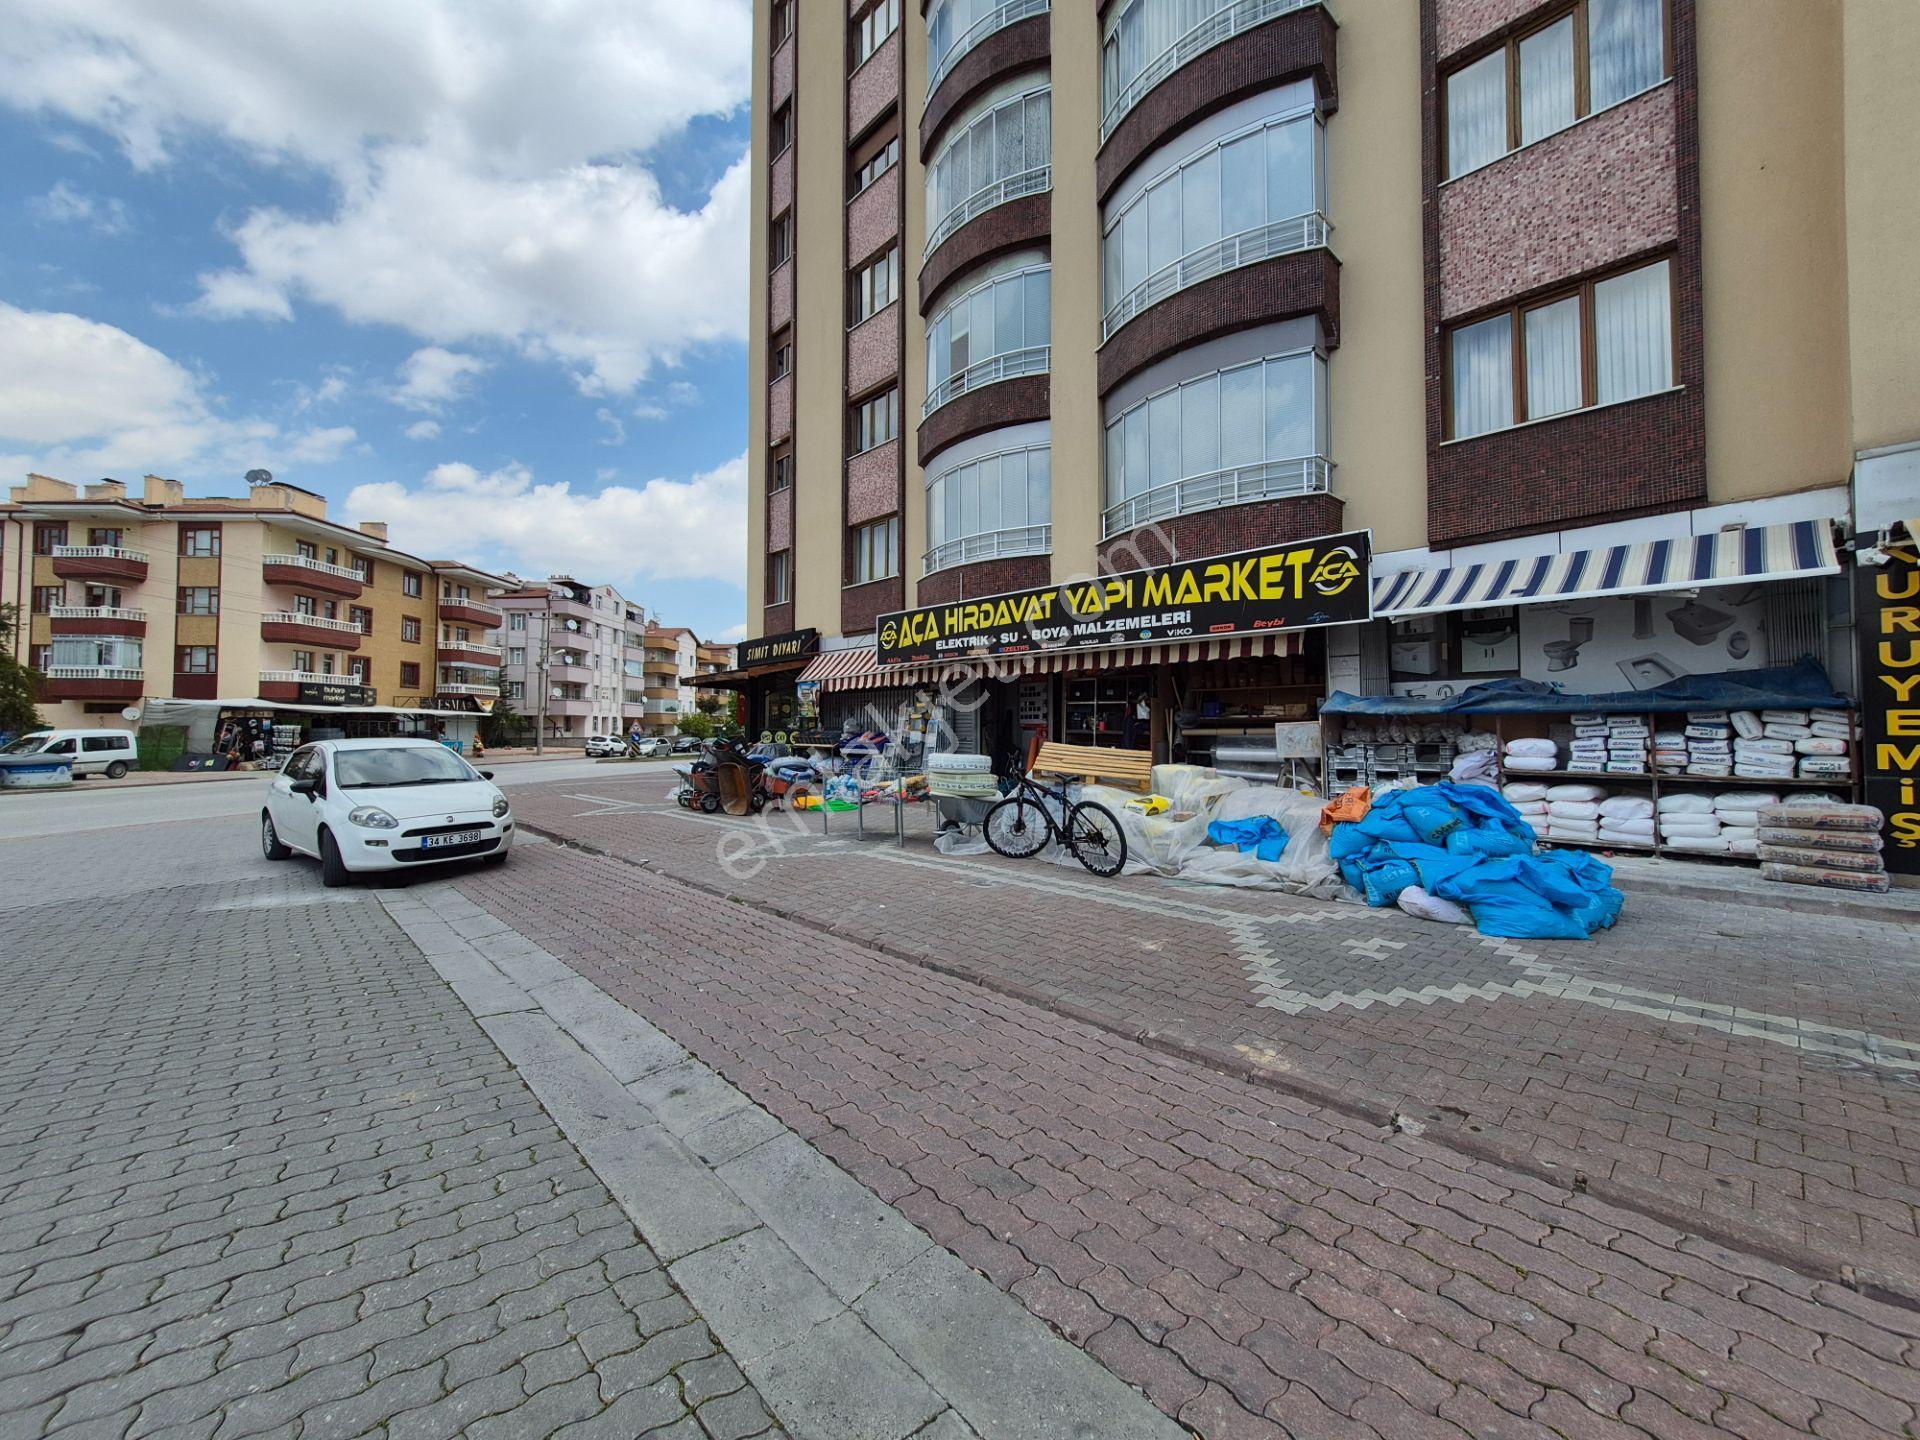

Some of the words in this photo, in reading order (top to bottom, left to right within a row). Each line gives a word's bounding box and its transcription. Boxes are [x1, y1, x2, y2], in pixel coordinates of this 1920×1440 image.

[898, 611, 940, 648] AÇA
[945, 592, 1058, 635] HIRDAVAT
[1065, 579, 1133, 614] YAPI
[1142, 548, 1315, 606] MARKET
[1001, 632, 1019, 644] SU
[1032, 626, 1070, 641] BOYA
[1073, 610, 1191, 635] MALZEMELERİ
[1254, 617, 1286, 629] Beybi
[429, 837, 440, 847] 34
[443, 835, 454, 844] KE
[459, 833, 479, 843] 3698
